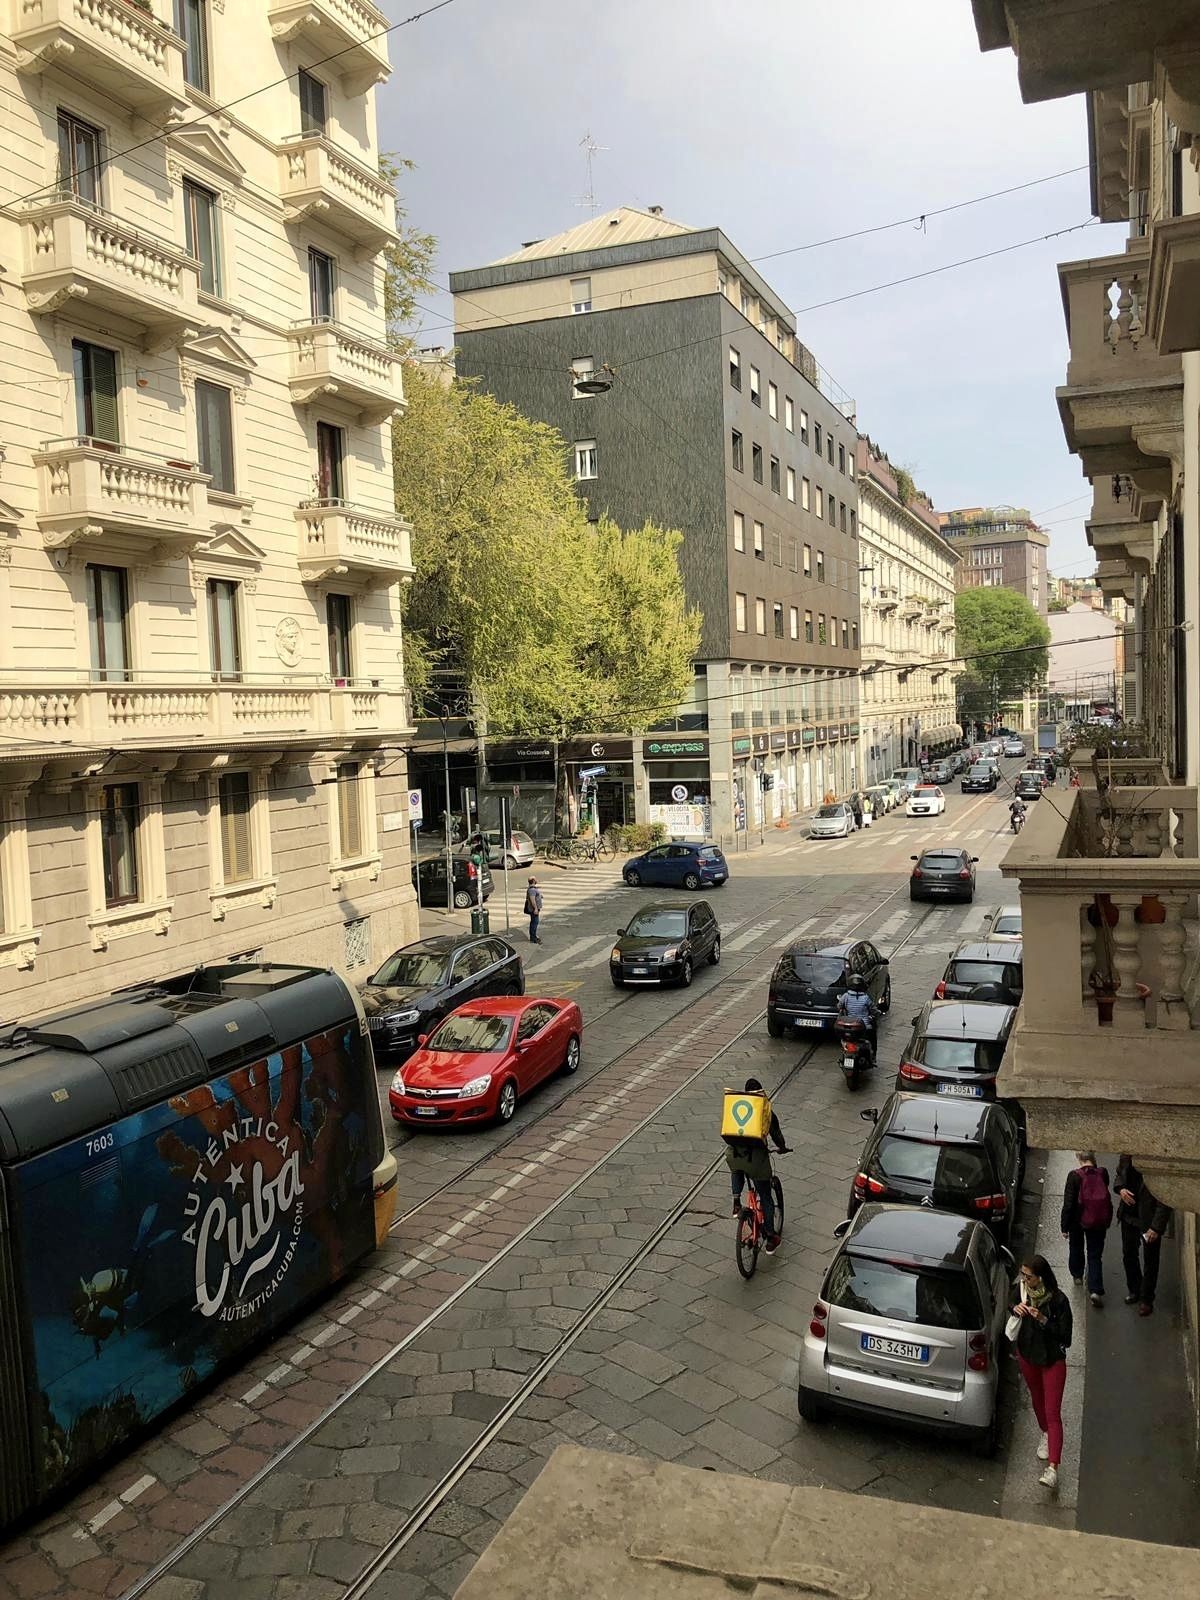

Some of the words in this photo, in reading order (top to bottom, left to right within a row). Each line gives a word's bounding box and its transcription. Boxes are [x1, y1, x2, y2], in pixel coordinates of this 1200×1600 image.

[661, 742, 705, 754] express
[86, 1132, 114, 1157] 7603
[191, 1149, 305, 1317] Cuba
[219, 1201, 304, 1322] AUTENTICACUBA.COM
[868, 1337, 882, 1350] DS
[887, 1341, 921, 1359] 343HY
